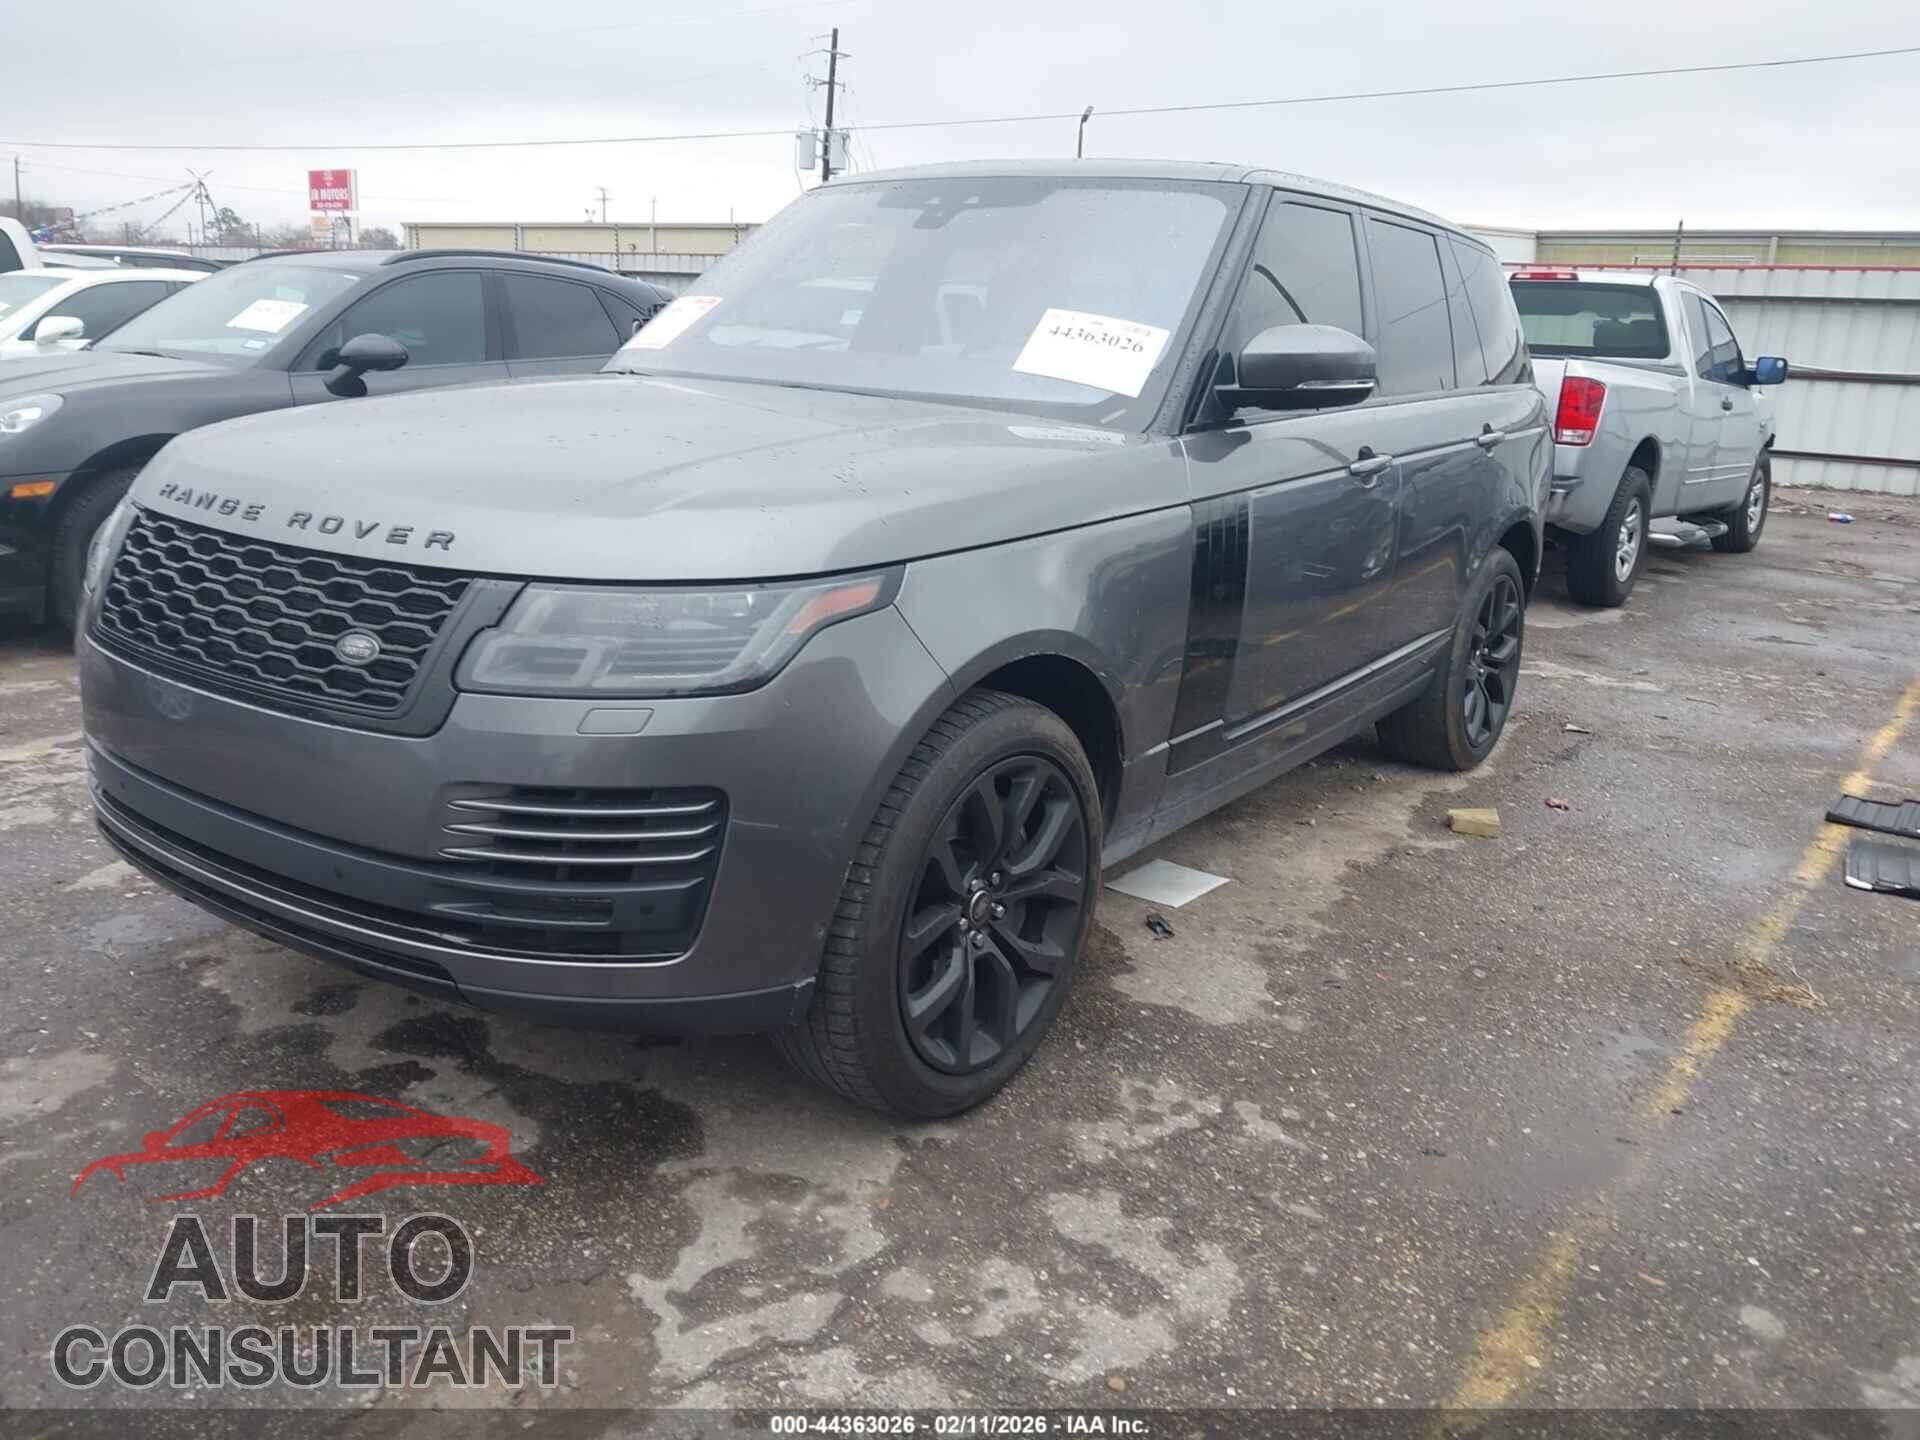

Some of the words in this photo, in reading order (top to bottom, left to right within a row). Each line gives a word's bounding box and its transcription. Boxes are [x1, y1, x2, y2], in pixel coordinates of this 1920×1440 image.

[320, 187, 349, 201] MOTORS
[1048, 325, 1144, 353] 44363026
[158, 482, 266, 522] RANGE
[287, 510, 455, 551] ROVER
